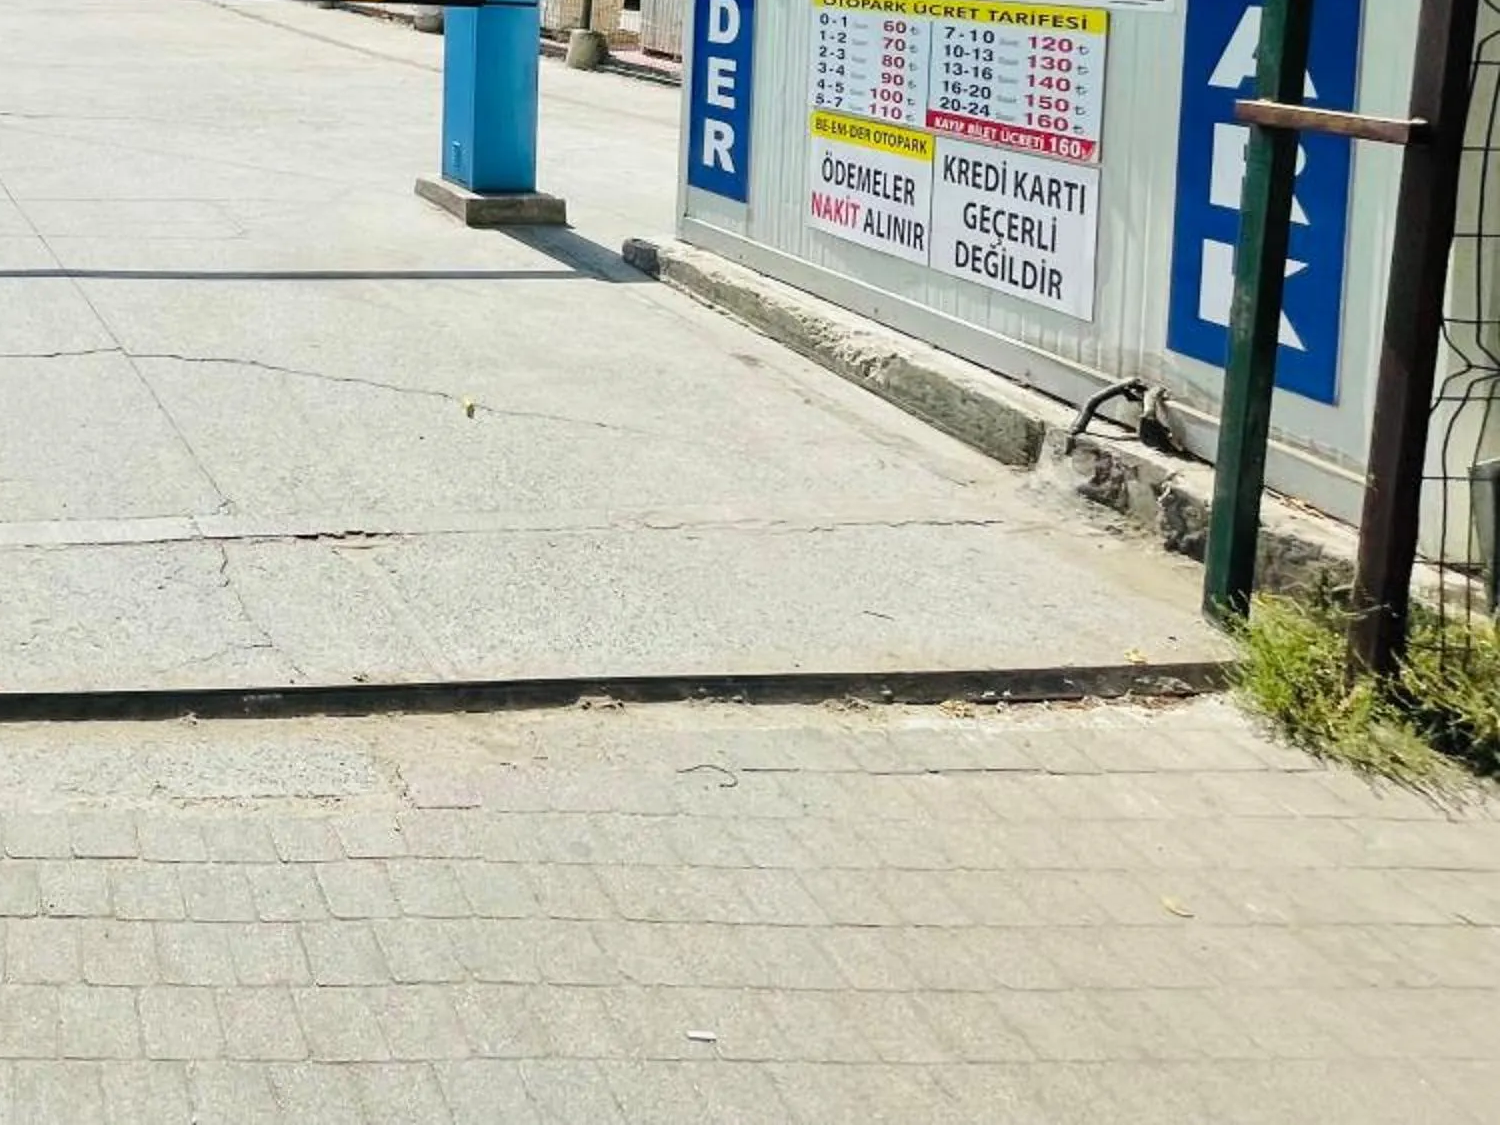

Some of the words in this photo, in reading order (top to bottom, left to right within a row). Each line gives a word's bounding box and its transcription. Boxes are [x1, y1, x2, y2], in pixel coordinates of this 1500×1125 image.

[913, 1, 980, 20] ÜCRET
[989, 10, 1088, 30] TARİFESİ
[943, 44, 993, 62] 10-13
[943, 62, 993, 80] 13-16
[939, 96, 990, 117] 20-24
[942, 80, 992, 100] 16-20
[815, 117, 871, 143] BE-EM-DER
[873, 130, 928, 155] OTOPARK
[967, 121, 998, 139] BİLET
[1001, 129, 1045, 150] ÜCRETİ
[821, 150, 915, 206] ÖDEMELER
[943, 154, 1007, 196] KREDİ
[1013, 170, 1087, 215] KARTI
[811, 192, 861, 229] NAKİT
[863, 208, 925, 252] ALINIR
[963, 202, 1057, 253] GEÇERLİ
[955, 240, 1063, 300] DEĞİLDİR
